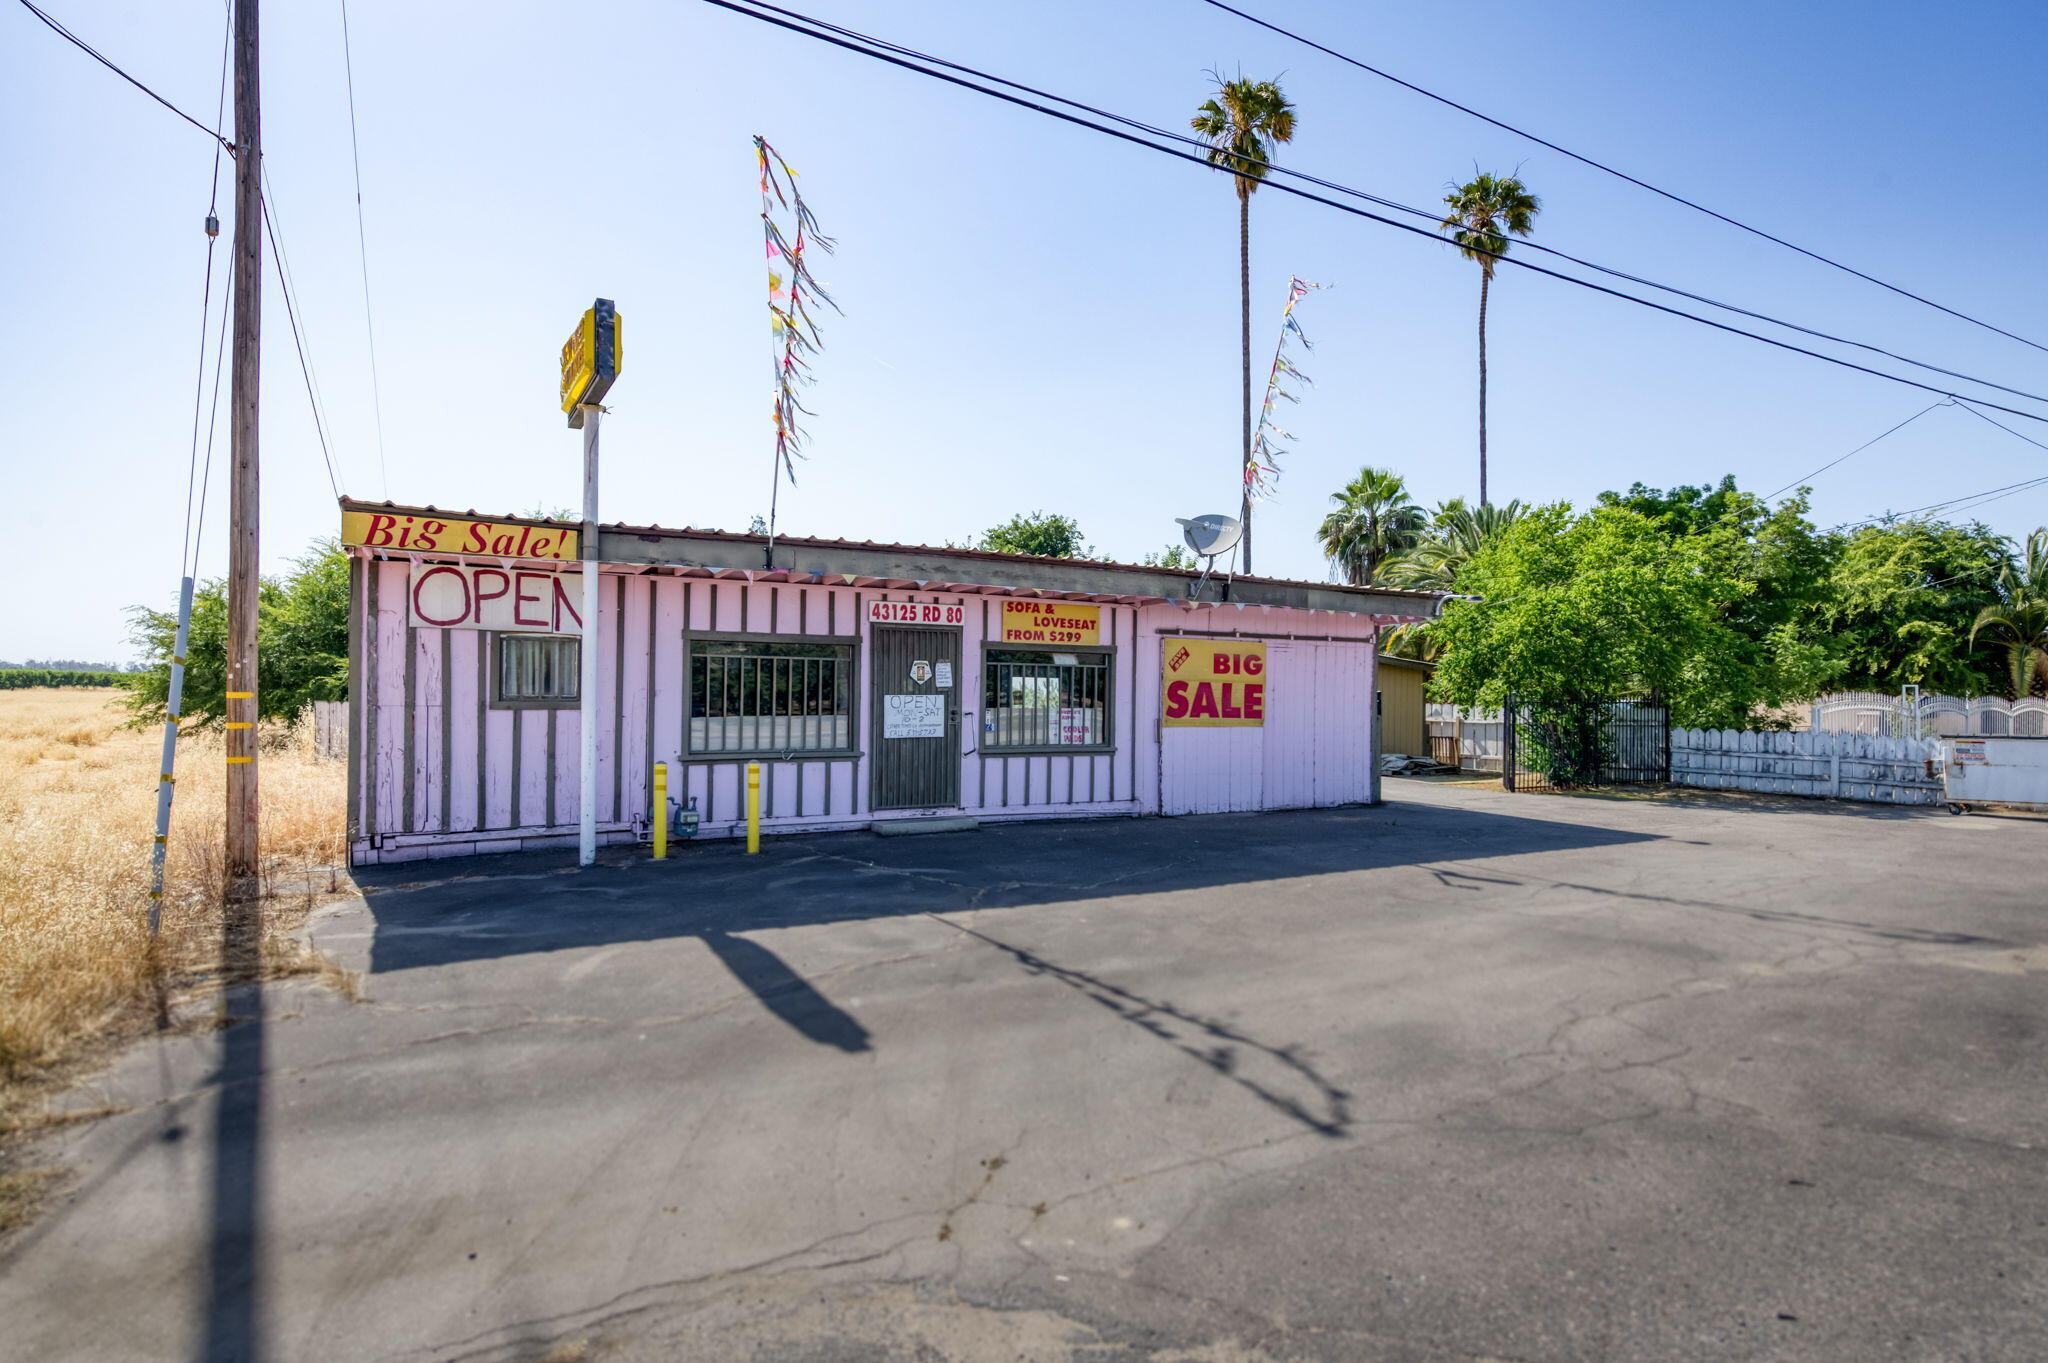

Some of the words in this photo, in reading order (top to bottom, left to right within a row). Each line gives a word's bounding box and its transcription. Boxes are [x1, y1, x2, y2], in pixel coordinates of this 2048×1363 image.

[364, 515, 447, 550] Big
[462, 522, 568, 559] Sale!
[413, 566, 583, 632] OPEN
[1006, 601, 1040, 613] SOFA
[1044, 603, 1055, 614] &
[872, 603, 917, 621] 43125
[922, 606, 941, 622] RD
[946, 607, 962, 623] 80
[1034, 617, 1096, 630] LOVESEAT
[1006, 629, 1045, 640] FROM
[1049, 631, 1082, 642] $299
[1213, 653, 1263, 676] BIG
[890, 695, 937, 709] OPEN
[1166, 680, 1263, 719] SALE
